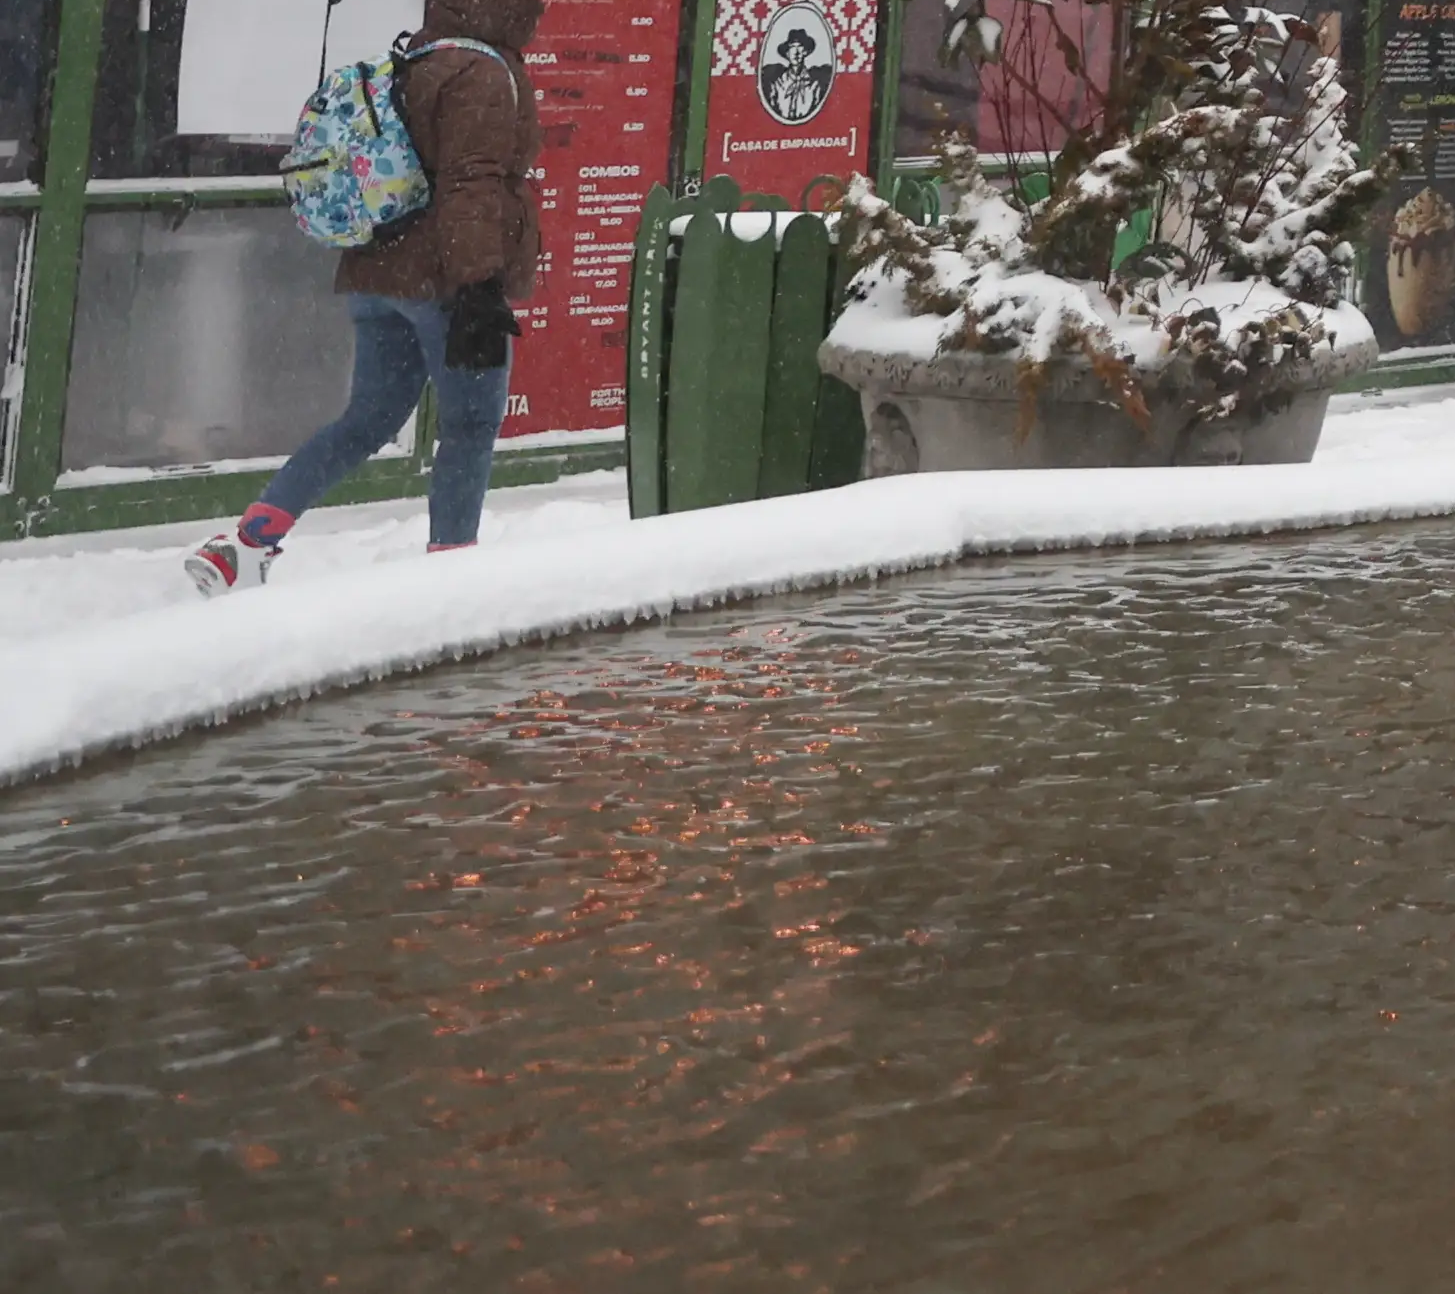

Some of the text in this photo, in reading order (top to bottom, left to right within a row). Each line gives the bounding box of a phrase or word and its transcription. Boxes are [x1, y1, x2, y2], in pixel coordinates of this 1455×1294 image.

[730, 137, 848, 152] CASA DE EMPANADAS
[579, 166, 640, 178] COMBOS
[640, 286, 652, 379] BRYANT
[610, 388, 627, 397] TH
[590, 397, 627, 407] PEOPL
